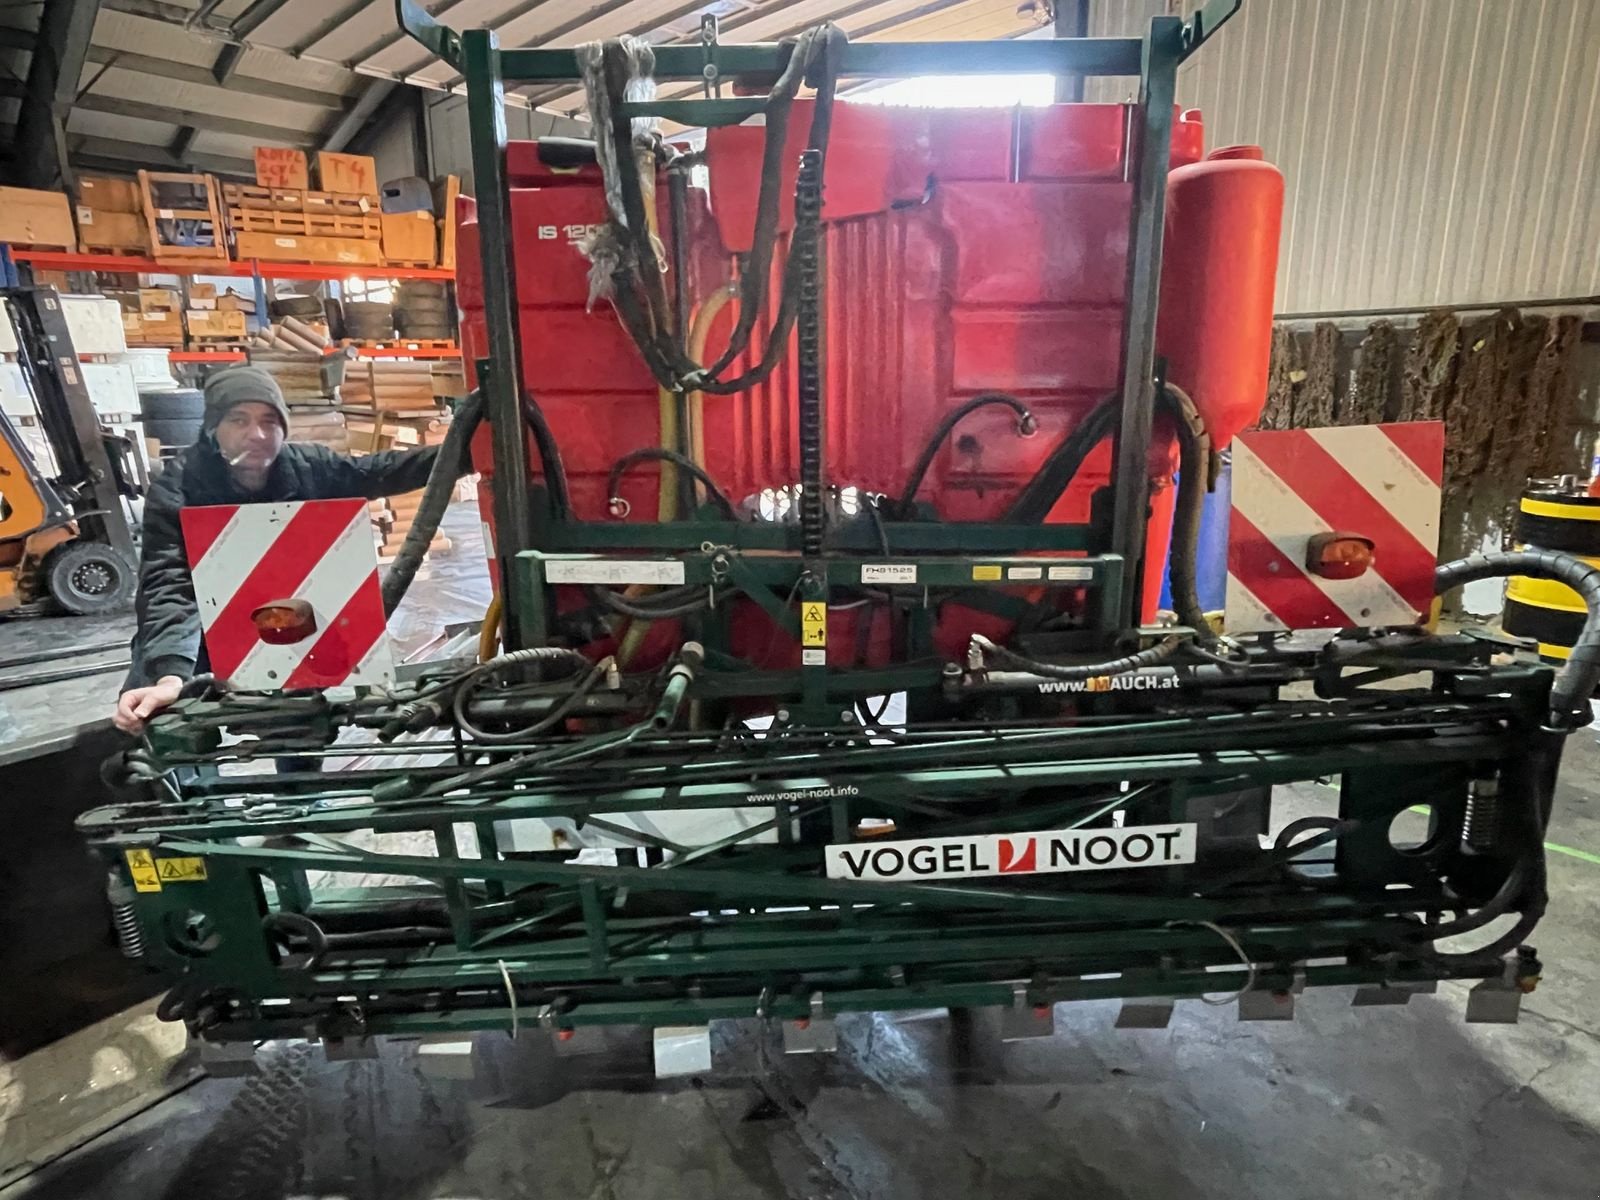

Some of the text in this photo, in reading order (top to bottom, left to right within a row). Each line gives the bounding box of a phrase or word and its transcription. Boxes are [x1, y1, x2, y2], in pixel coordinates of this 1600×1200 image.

[538, 225, 558, 240] IS
[746, 785, 860, 803] www.vogel-noot.info
[842, 831, 1181, 878] VOGEL NOOT
